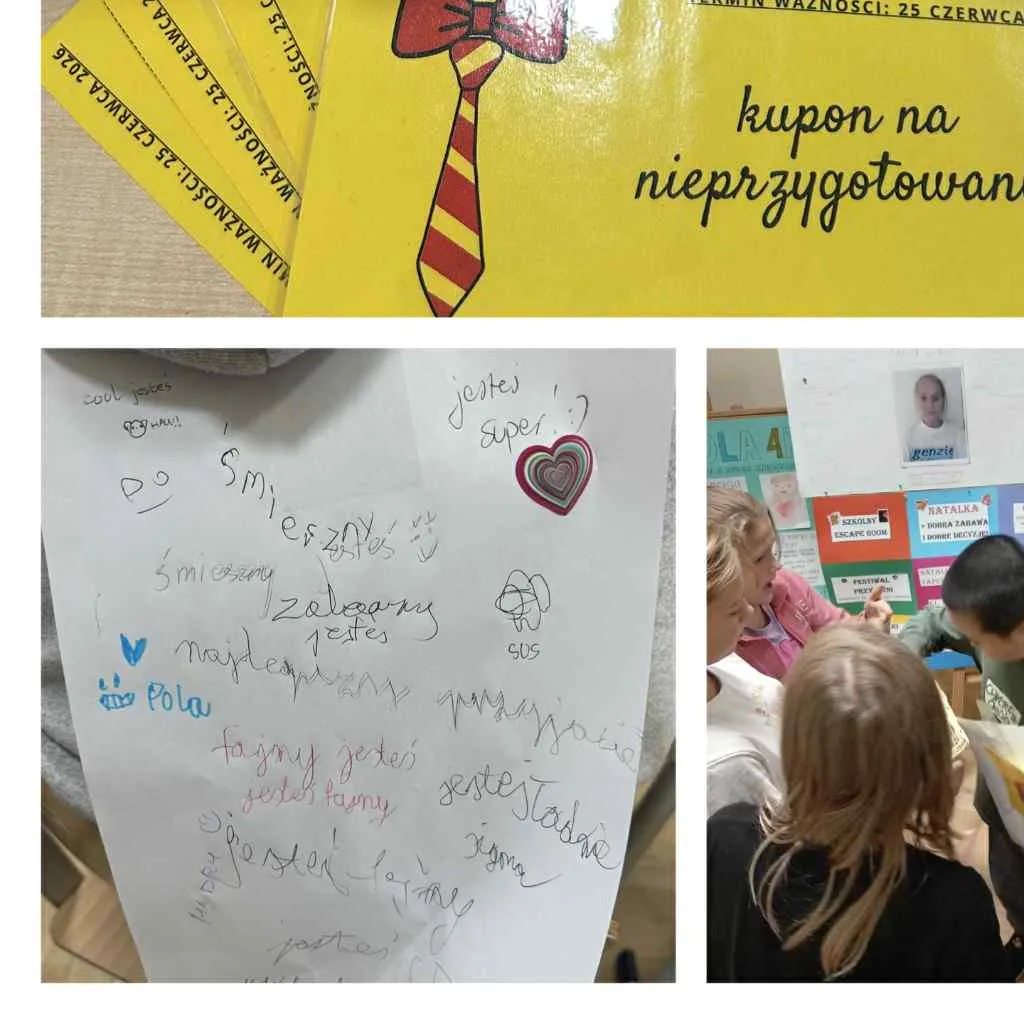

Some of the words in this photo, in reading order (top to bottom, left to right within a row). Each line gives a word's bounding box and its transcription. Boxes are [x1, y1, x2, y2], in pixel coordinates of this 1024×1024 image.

[268, 12, 289, 34] 25
[899, 2, 921, 18] 25
[152, 6, 209, 81] CZERWCA
[52, 47, 90, 83] 2026
[206, 83, 226, 105] 25
[88, 79, 156, 148] CZERWCA
[736, 84, 885, 159] kupon
[896, 104, 960, 134] na
[155, 146, 177, 169] 25
[224, 105, 294, 203] WAŻNOŚCI:
[177, 167, 264, 254] WAŻNOŚCI:
[928, 503, 980, 516] NATALKA
[148, 682, 211, 718] Pola
